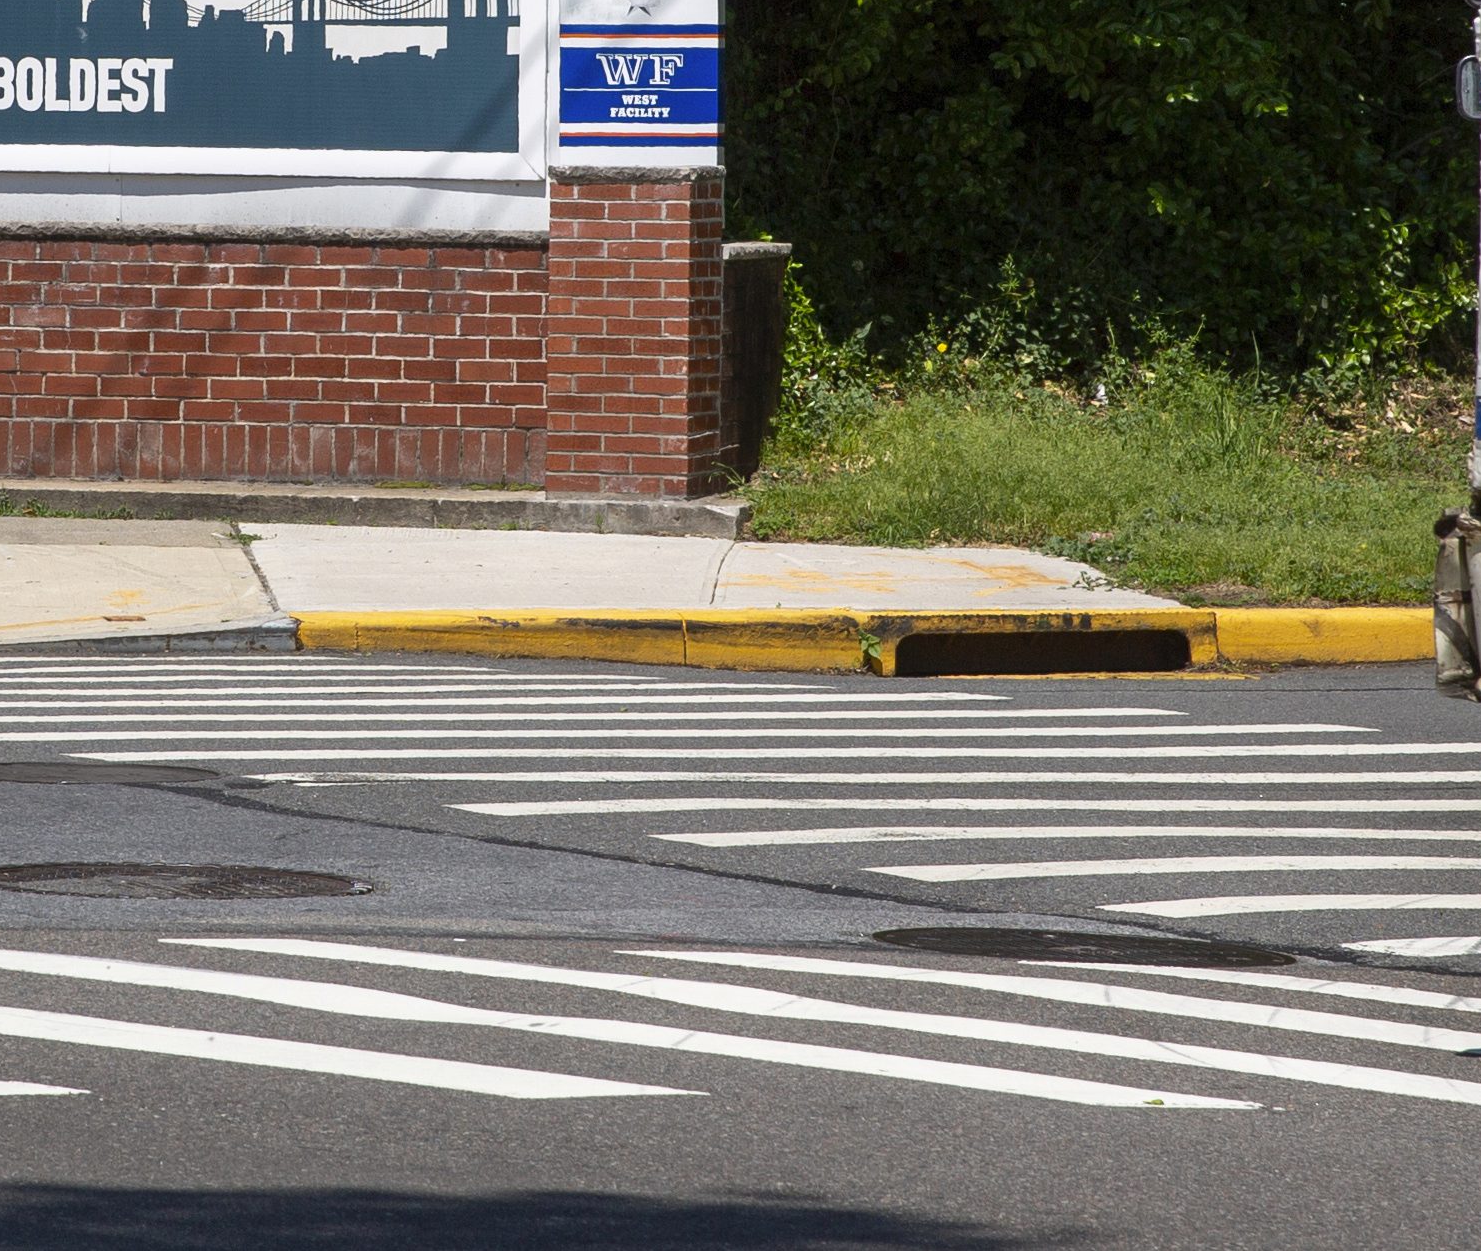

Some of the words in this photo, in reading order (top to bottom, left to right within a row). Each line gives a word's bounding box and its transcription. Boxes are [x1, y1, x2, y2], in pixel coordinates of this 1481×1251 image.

[596, 53, 684, 85] WF
[622, 95, 658, 105] WEST
[610, 107, 670, 118] FACILITY
